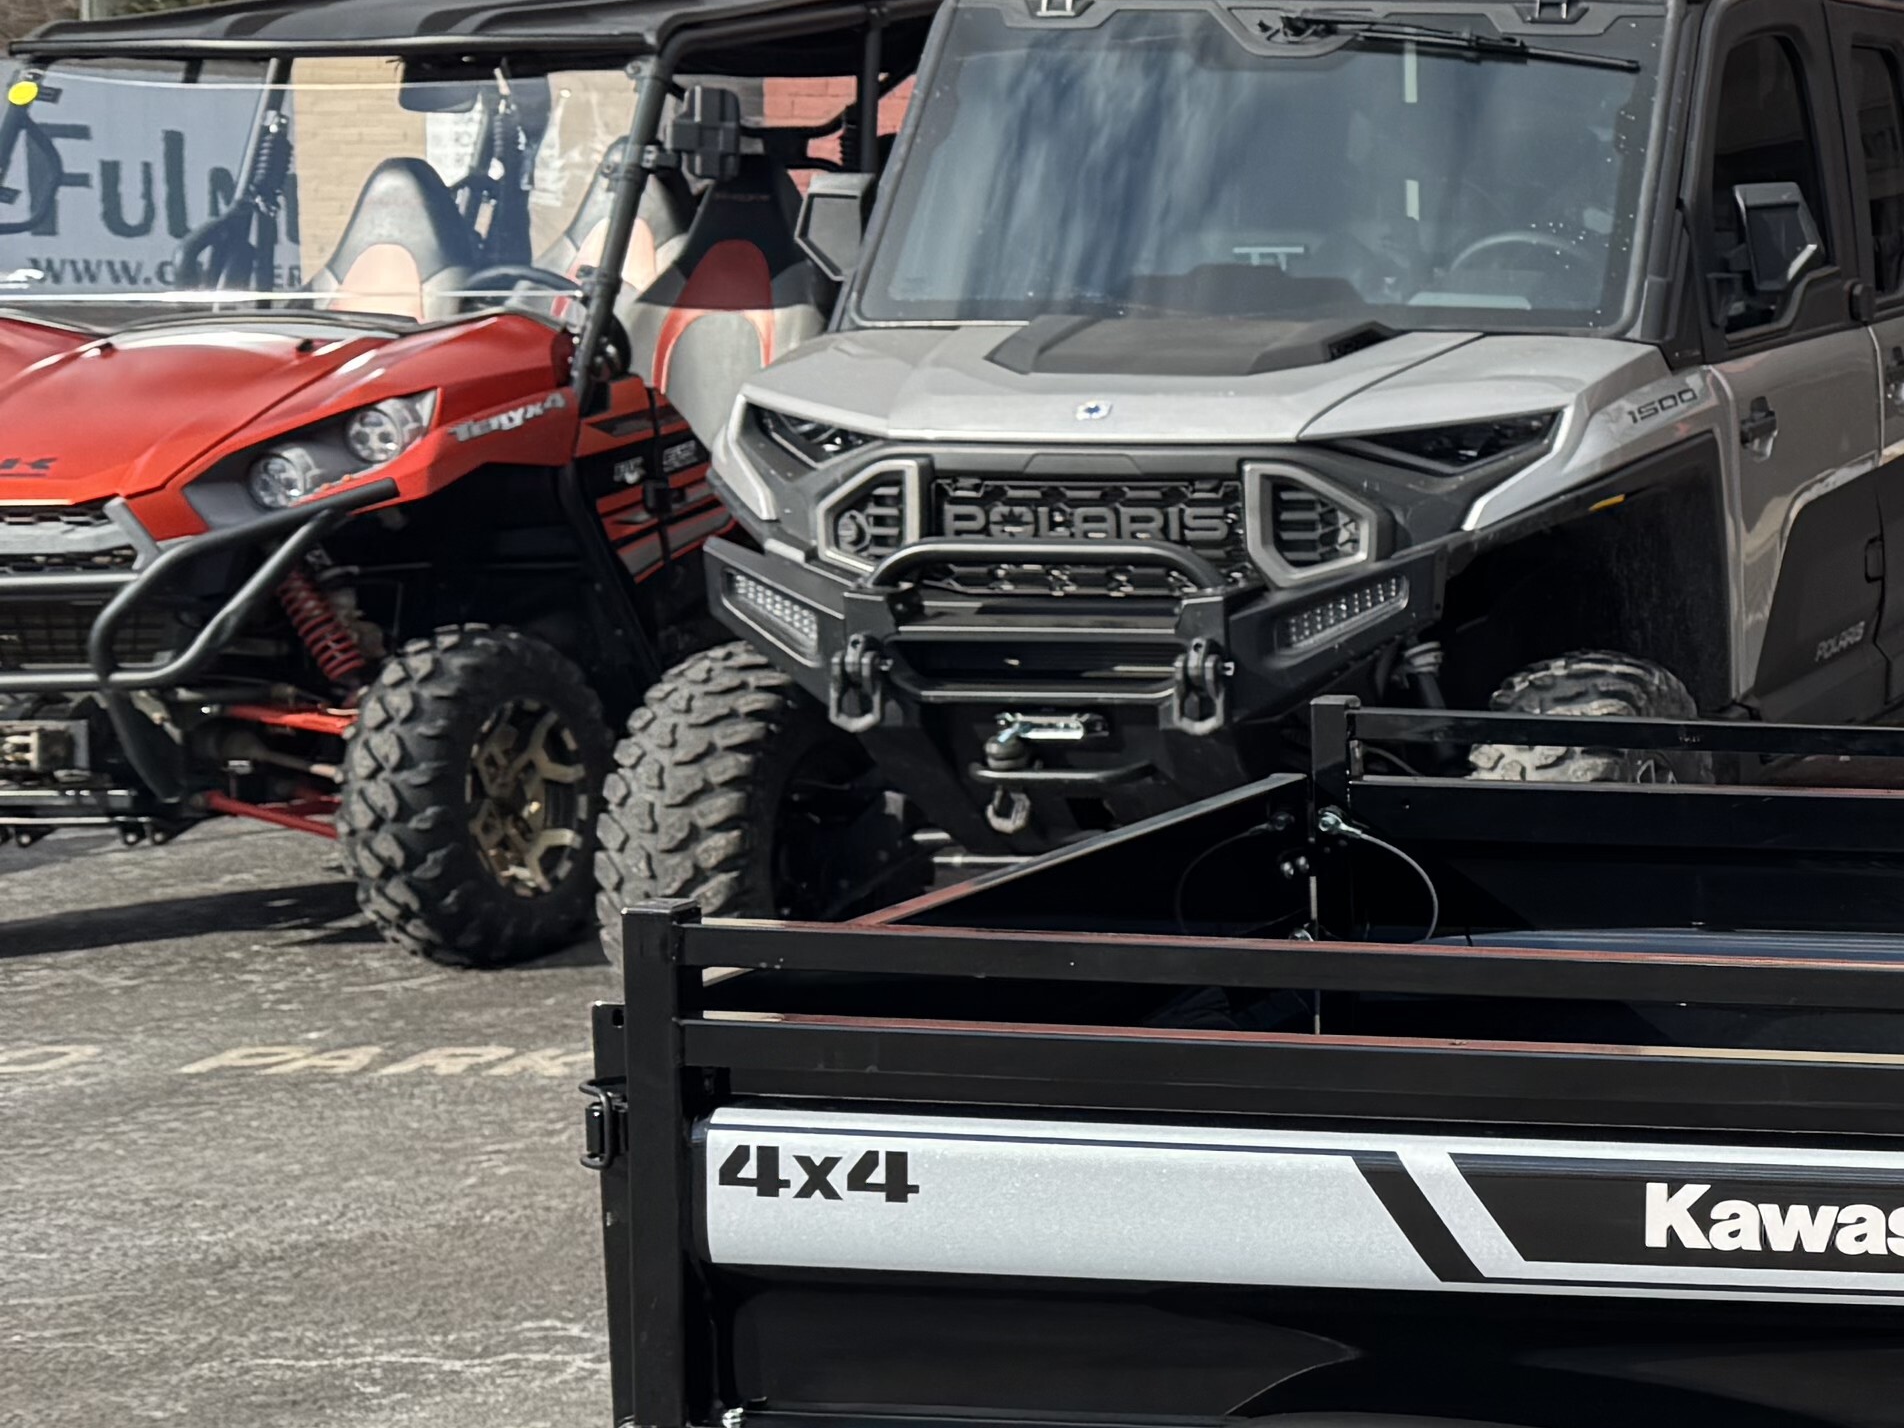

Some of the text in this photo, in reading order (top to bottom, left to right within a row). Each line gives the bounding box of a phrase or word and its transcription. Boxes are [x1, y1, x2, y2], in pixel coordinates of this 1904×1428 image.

[1626, 387, 1699, 425] 1500
[943, 504, 1230, 542] POLARIS
[717, 1143, 921, 1205] 4x4
